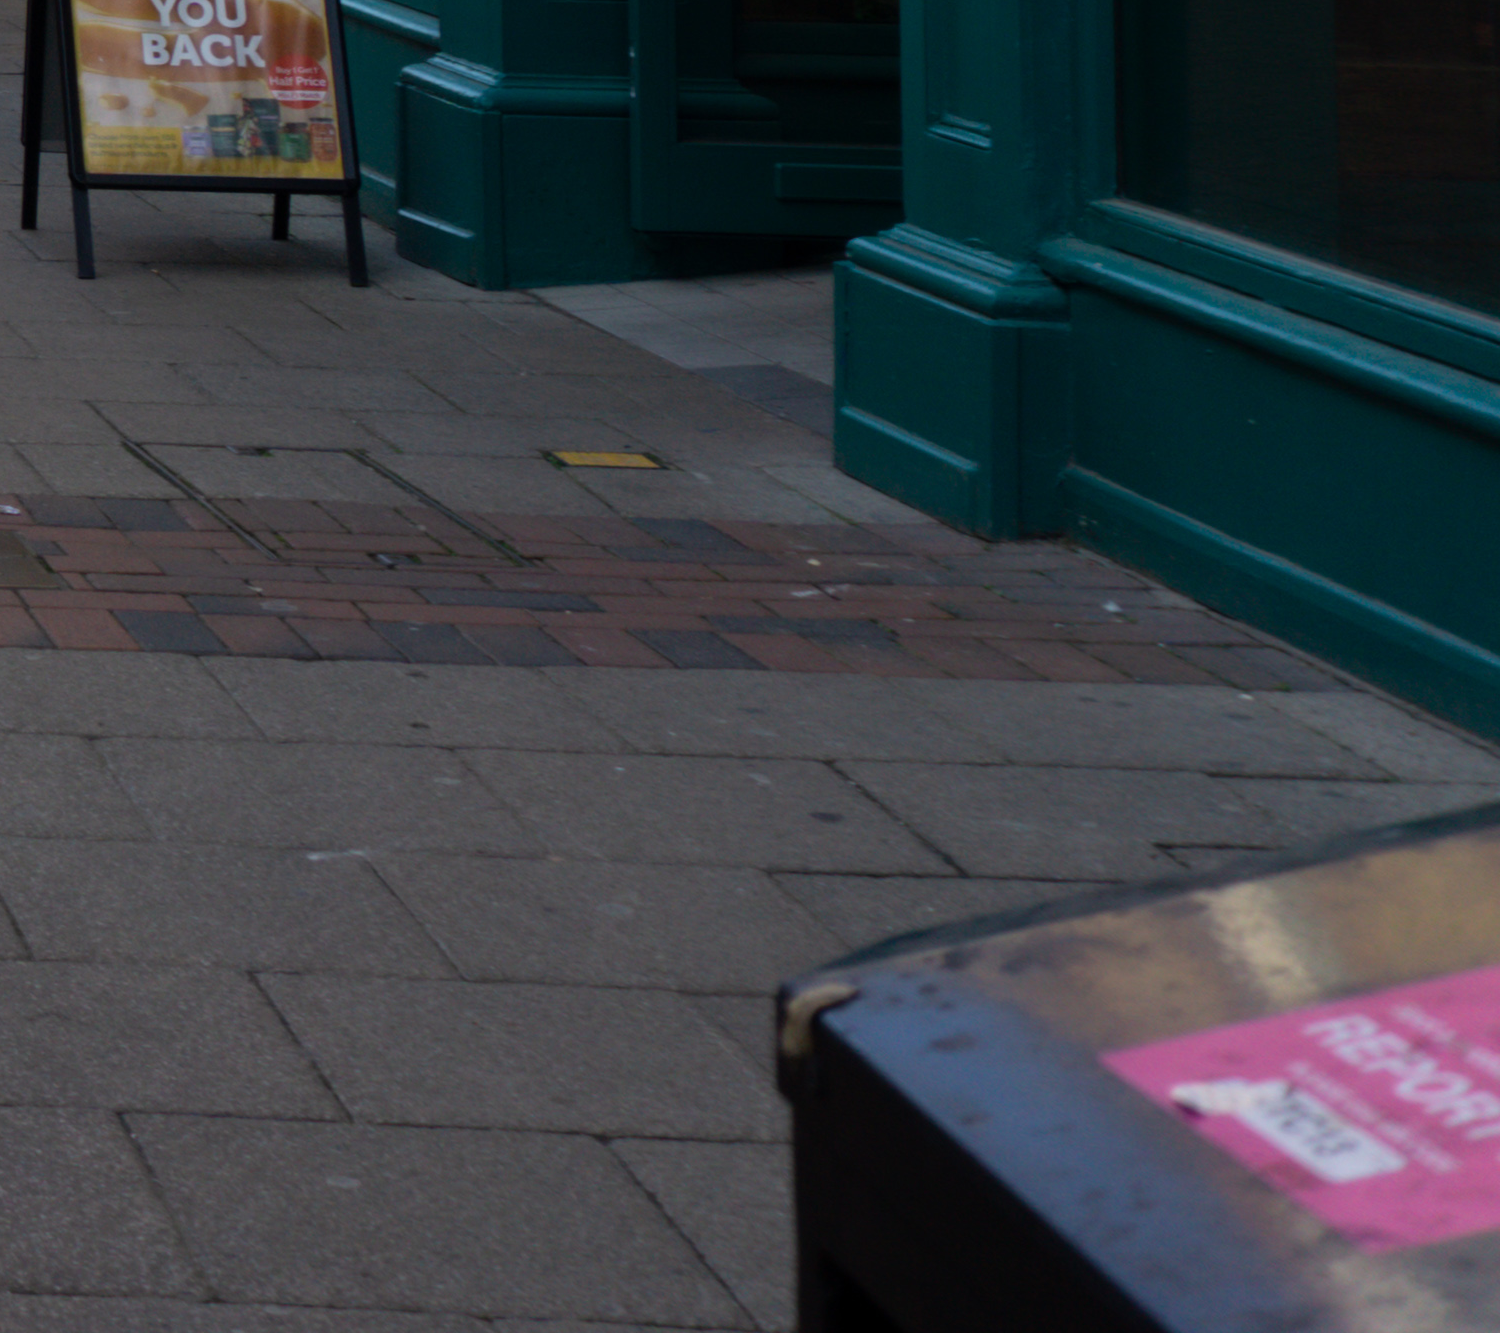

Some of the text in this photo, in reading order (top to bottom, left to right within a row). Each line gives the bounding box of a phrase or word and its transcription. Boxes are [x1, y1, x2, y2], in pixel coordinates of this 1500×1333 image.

[141, 33, 266, 68] BACK
[268, 76, 326, 86] Half Price
